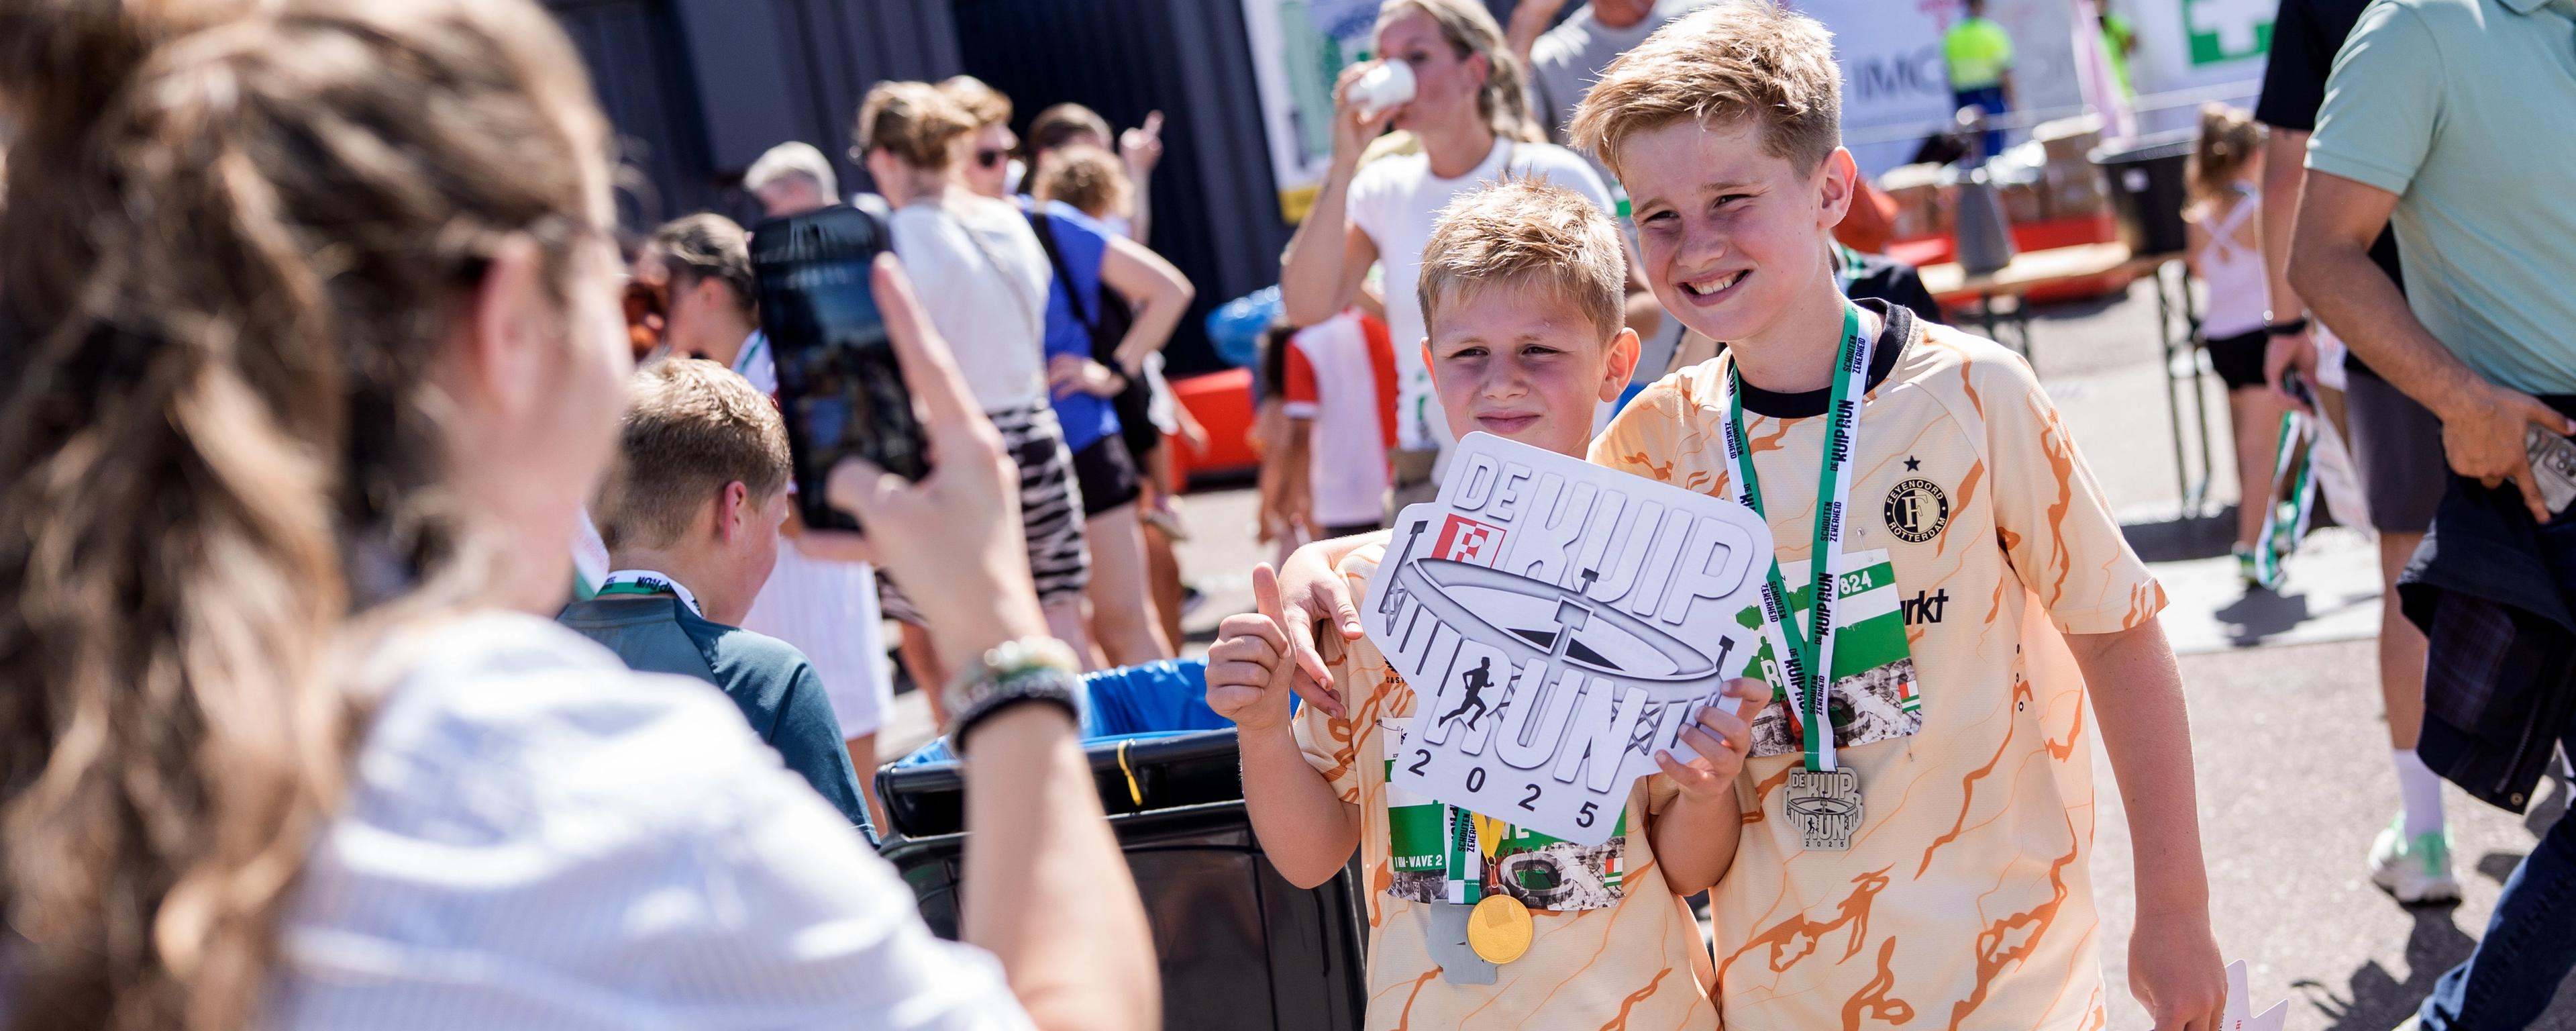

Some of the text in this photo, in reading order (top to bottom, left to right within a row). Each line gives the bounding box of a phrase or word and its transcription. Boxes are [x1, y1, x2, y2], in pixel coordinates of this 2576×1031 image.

[1843, 335, 1857, 373] SCHOUTEN
[1852, 338, 1865, 374] ZEKERHEID
[1725, 422, 1737, 459] ZEKERHEID
[1731, 418, 1744, 455] SCHOUTEN
[1830, 461, 1839, 471] DE
[1744, 483, 1752, 493] DE
[1887, 480, 1943, 504] FEYENOORD
[1820, 501, 1833, 542] SCHOUTEN
[1829, 501, 1841, 542] ZEKERHEID
[1889, 517, 1946, 542] ROTTERDAM
[1902, 495, 1928, 528] F
[1452, 452, 1755, 626] DE KUIP
[1761, 583, 1778, 623] ZEKERHEID
[1769, 581, 1788, 619] SCHOUTEN
[1900, 589, 1949, 626] rkt
[1789, 648, 1798, 658] DE
[1814, 635, 1822, 645] DE
[1809, 675, 1818, 714] SCHOUTEN
[1816, 675, 1825, 716] ZEKERHEID
[1424, 638, 1649, 794] RUN
[1792, 773, 1853, 799] DE KUIP
[1457, 813, 1471, 852] SCHOUTEN
[1466, 814, 1477, 852] ZEKERH
[1805, 814, 1846, 840] RUN
[1435, 854, 1443, 866] 2
